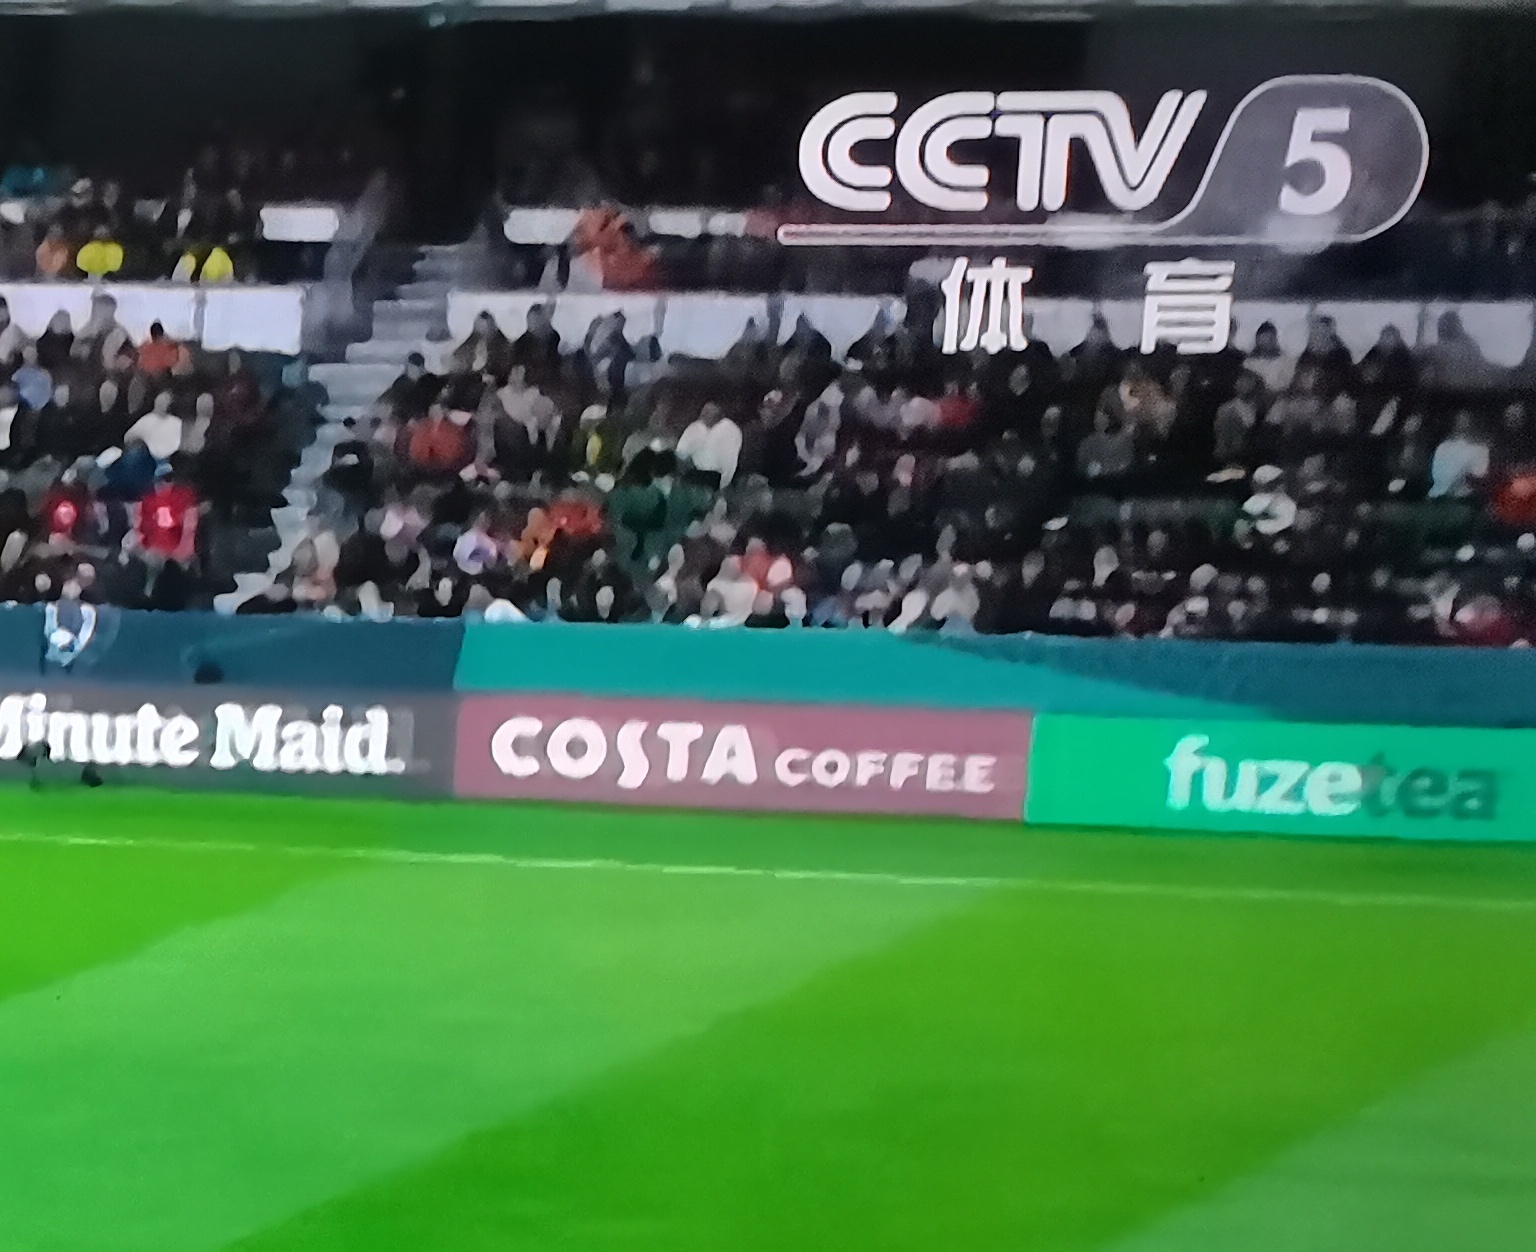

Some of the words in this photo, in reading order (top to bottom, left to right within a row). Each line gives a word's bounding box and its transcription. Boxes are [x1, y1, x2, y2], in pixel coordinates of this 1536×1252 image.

[798, 89, 1208, 212] CCTV
[1278, 107, 1352, 216] 5
[938, 256, 1234, 356] 体育
[491, 716, 758, 789] COSTA
[774, 747, 998, 794] COFFEE
